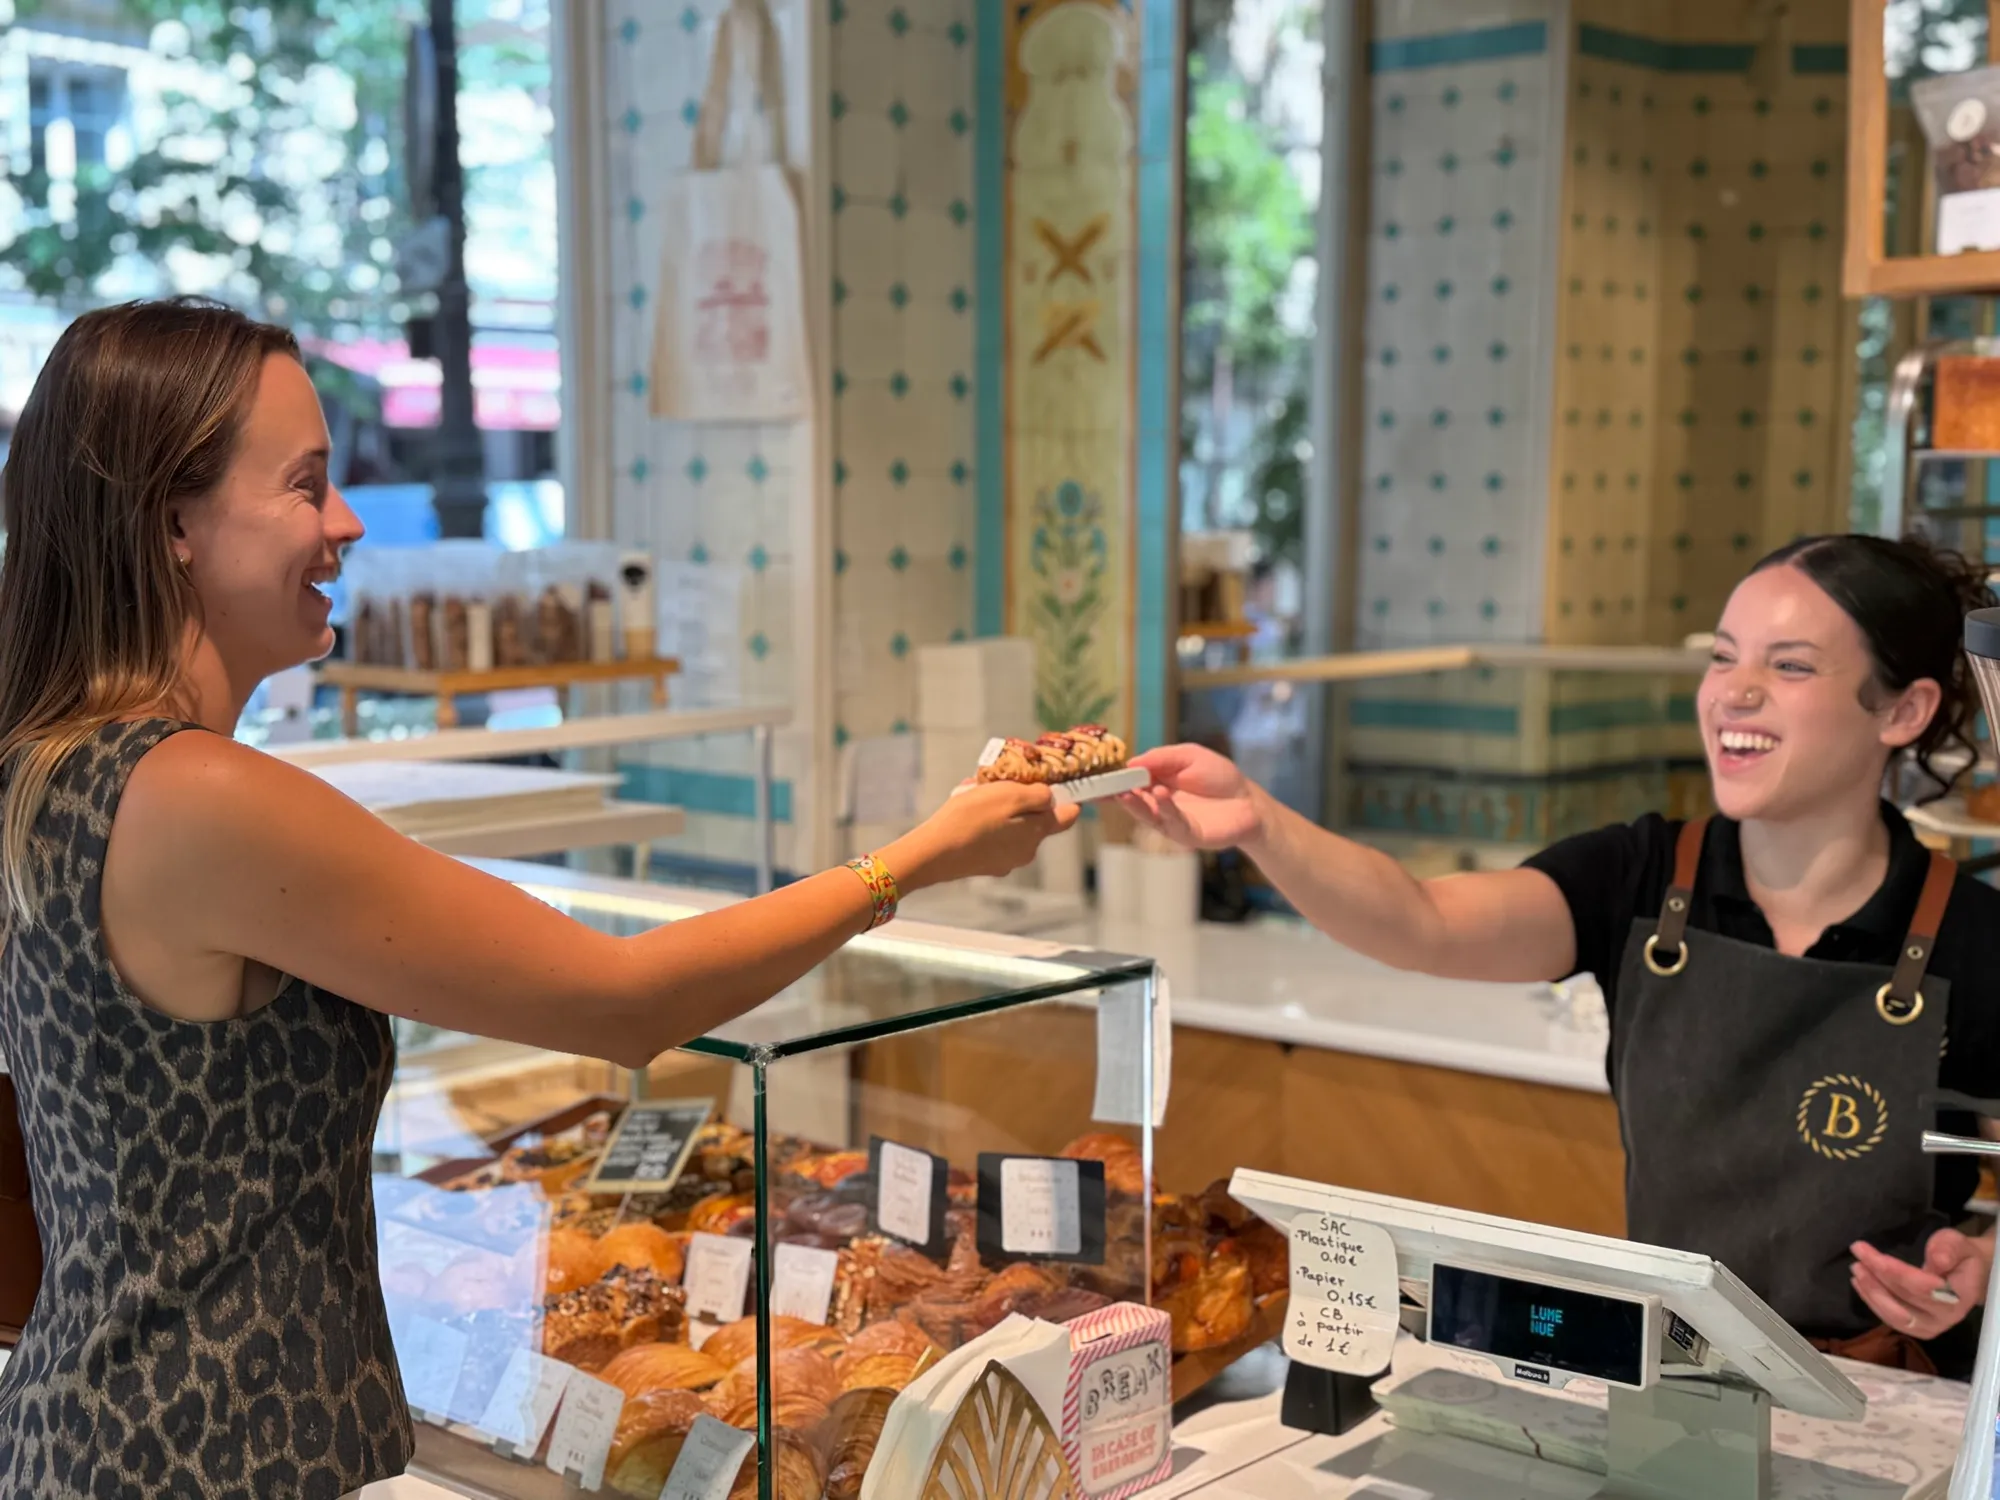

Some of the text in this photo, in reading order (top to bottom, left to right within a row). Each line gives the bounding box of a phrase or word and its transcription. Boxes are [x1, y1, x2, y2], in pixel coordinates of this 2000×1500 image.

[1822, 1092, 1861, 1139] B
[1319, 1217, 1351, 1236] SAC
[1297, 1229, 1365, 1254] Plastique
[1299, 1266, 1345, 1287] Papier
[1319, 1307, 1343, 1321] CB
[1316, 1321, 1364, 1337] partir
[1297, 1333, 1313, 1347] de
[1107, 1430, 1138, 1457] CASE
